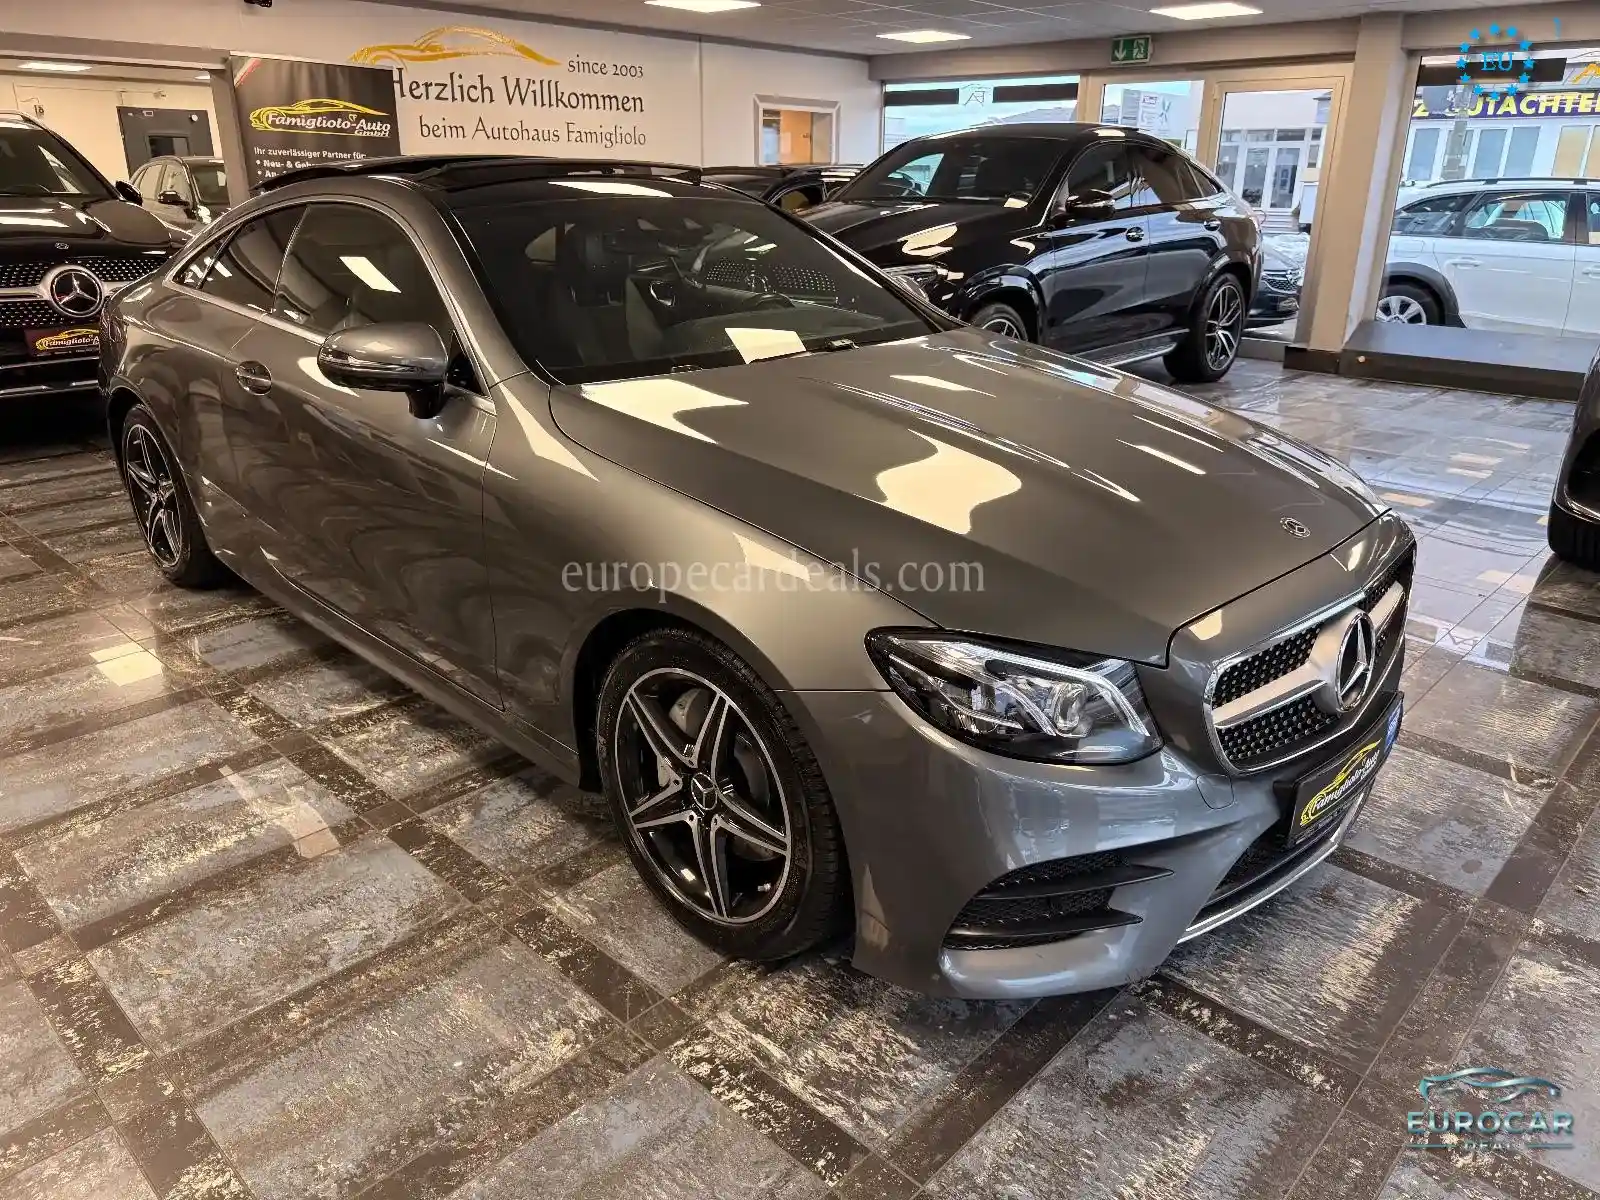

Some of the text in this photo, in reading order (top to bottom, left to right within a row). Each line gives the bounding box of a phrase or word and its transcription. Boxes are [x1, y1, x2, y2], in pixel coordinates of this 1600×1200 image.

[567, 54, 644, 78] since 2003
[393, 67, 645, 112] Herzlich Willkommen
[419, 115, 646, 149] beim Autohaus Famigliolo
[254, 147, 265, 155] Ihr
[268, 148, 321, 159] zuverlässiger
[322, 150, 351, 159] Partner
[263, 160, 284, 168] Neu-
[286, 161, 293, 169] &
